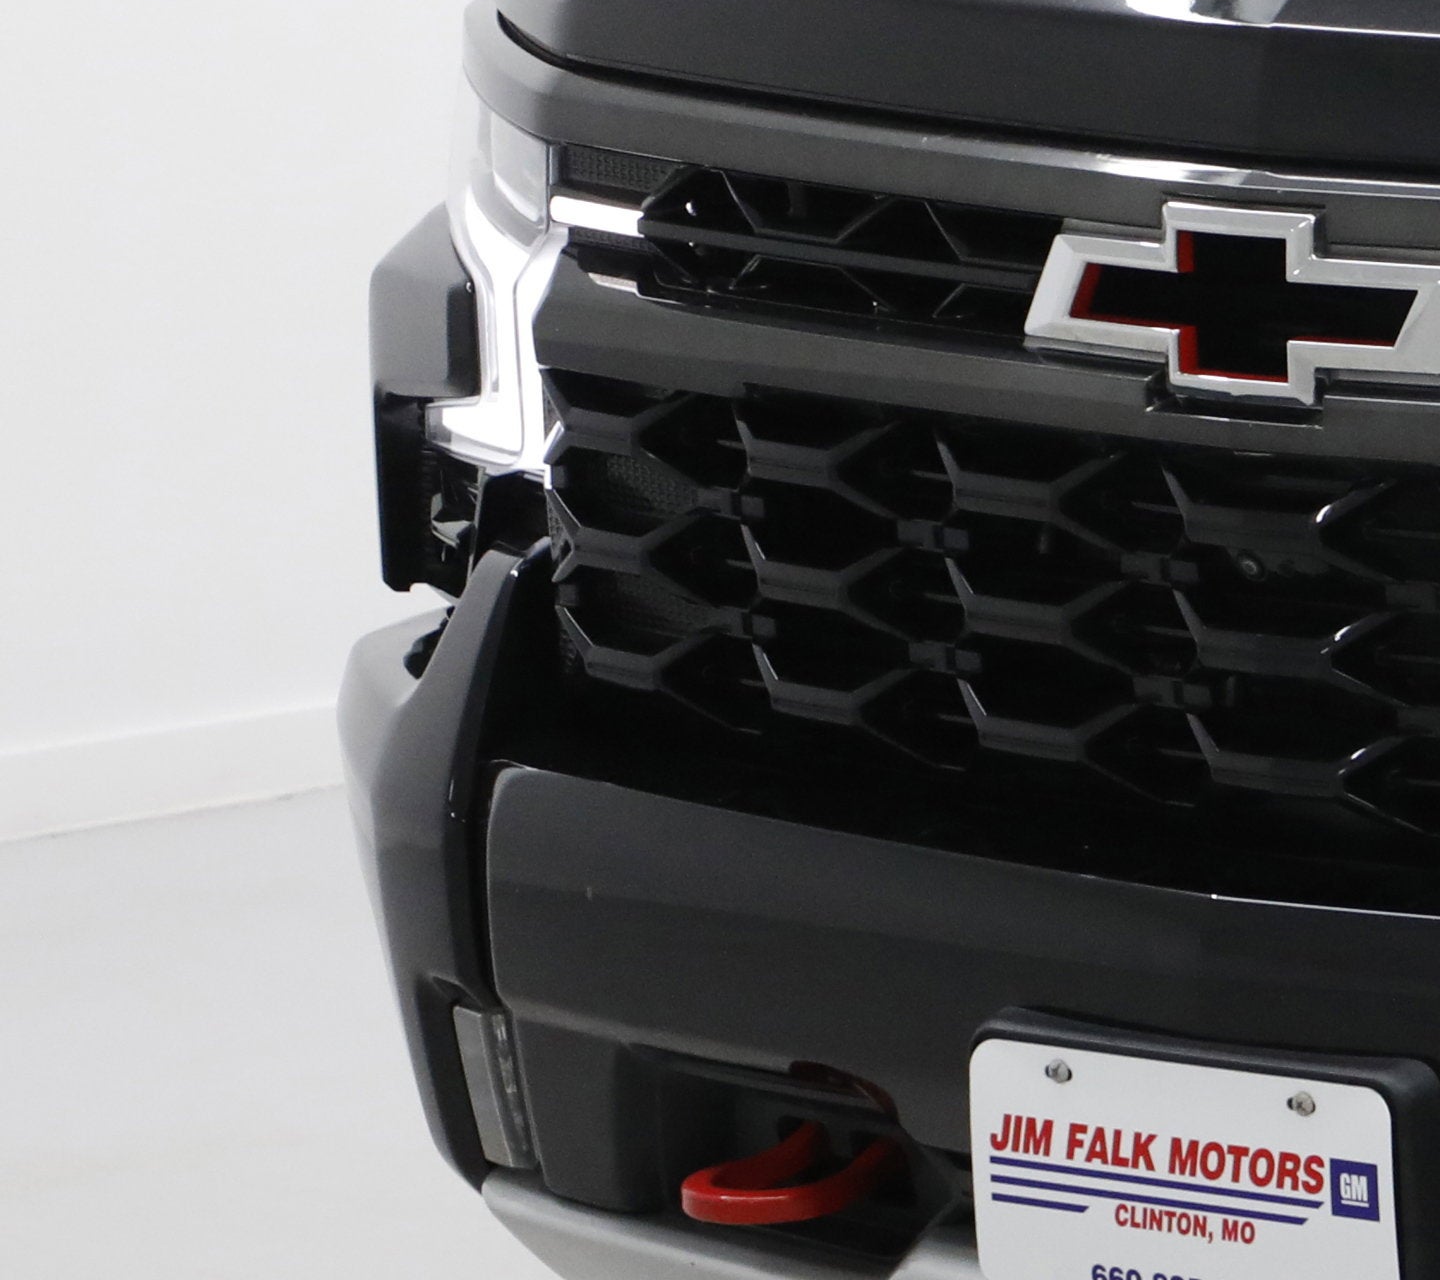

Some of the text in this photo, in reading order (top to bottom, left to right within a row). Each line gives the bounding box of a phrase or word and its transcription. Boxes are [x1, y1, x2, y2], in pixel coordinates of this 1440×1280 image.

[990, 1114, 1325, 1195] JIM FALK MOTORS
[1339, 1172, 1369, 1204] GM
[1114, 1203, 1256, 1244] CLINTON, MO
